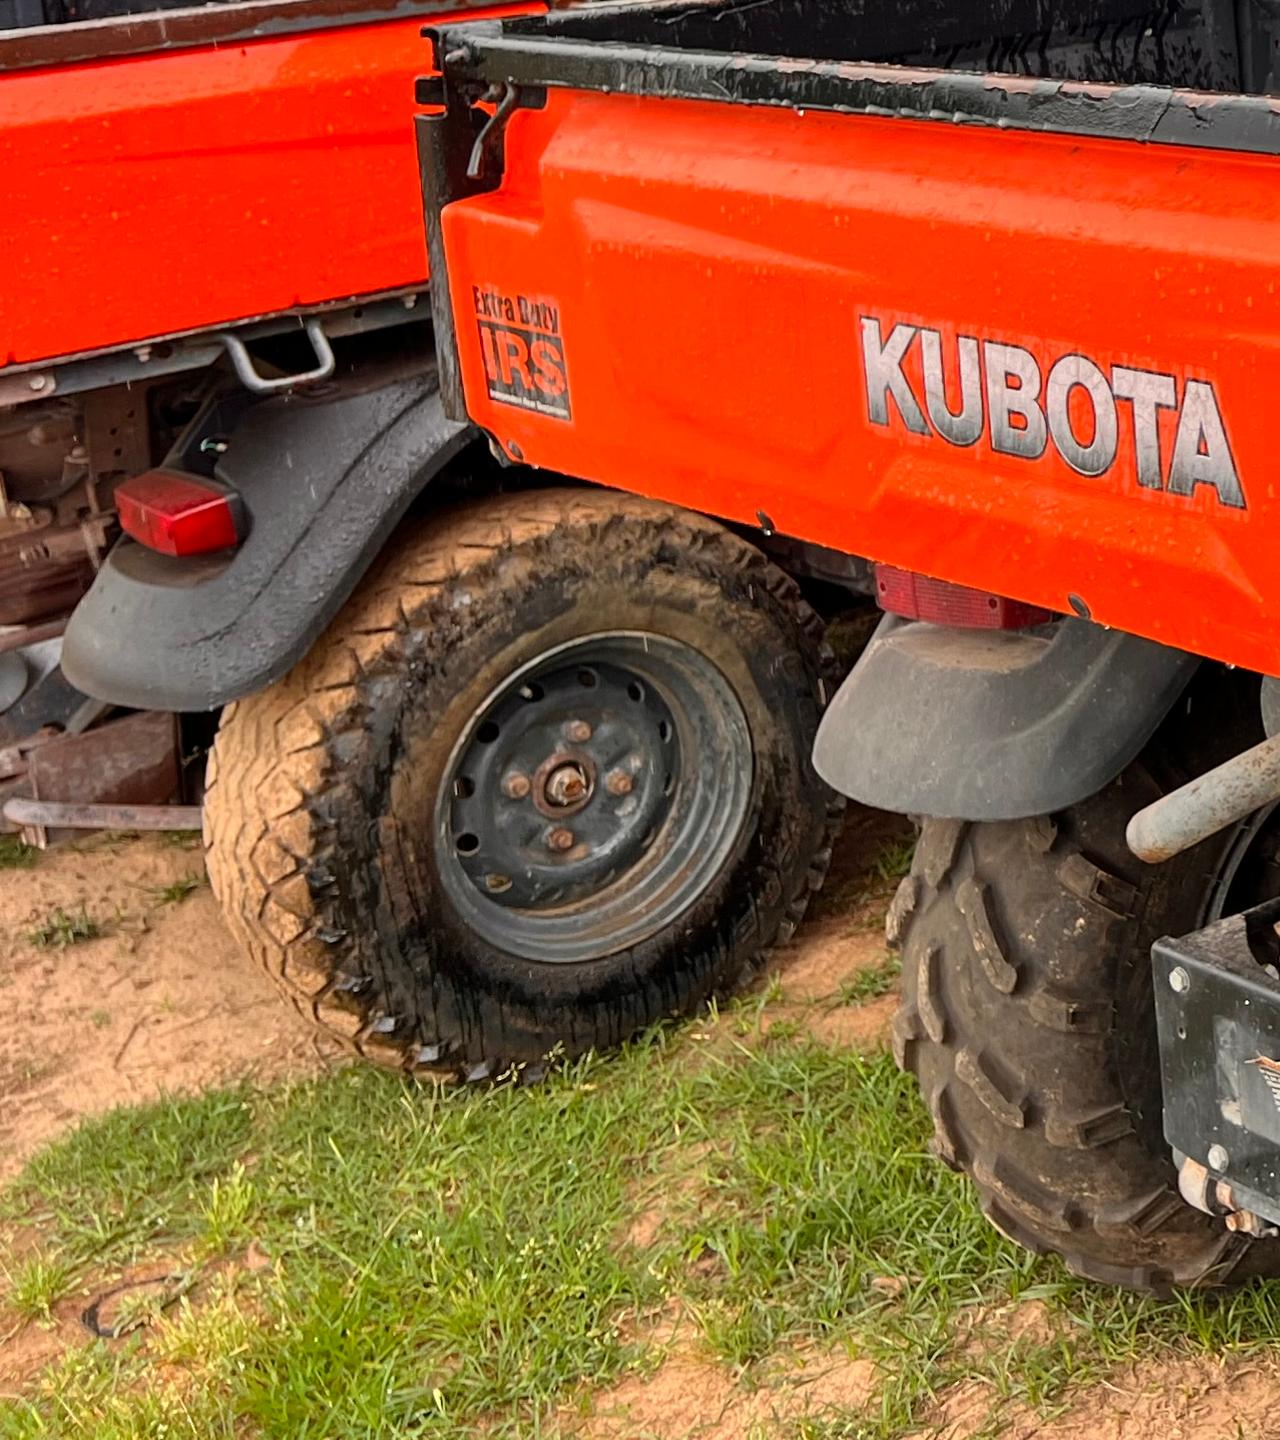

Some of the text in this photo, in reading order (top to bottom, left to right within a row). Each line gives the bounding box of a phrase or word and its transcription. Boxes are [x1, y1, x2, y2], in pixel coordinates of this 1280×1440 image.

[472, 285, 558, 334] Extra Duty
[480, 325, 566, 396] IRS
[858, 314, 1249, 511] KUBOTA
